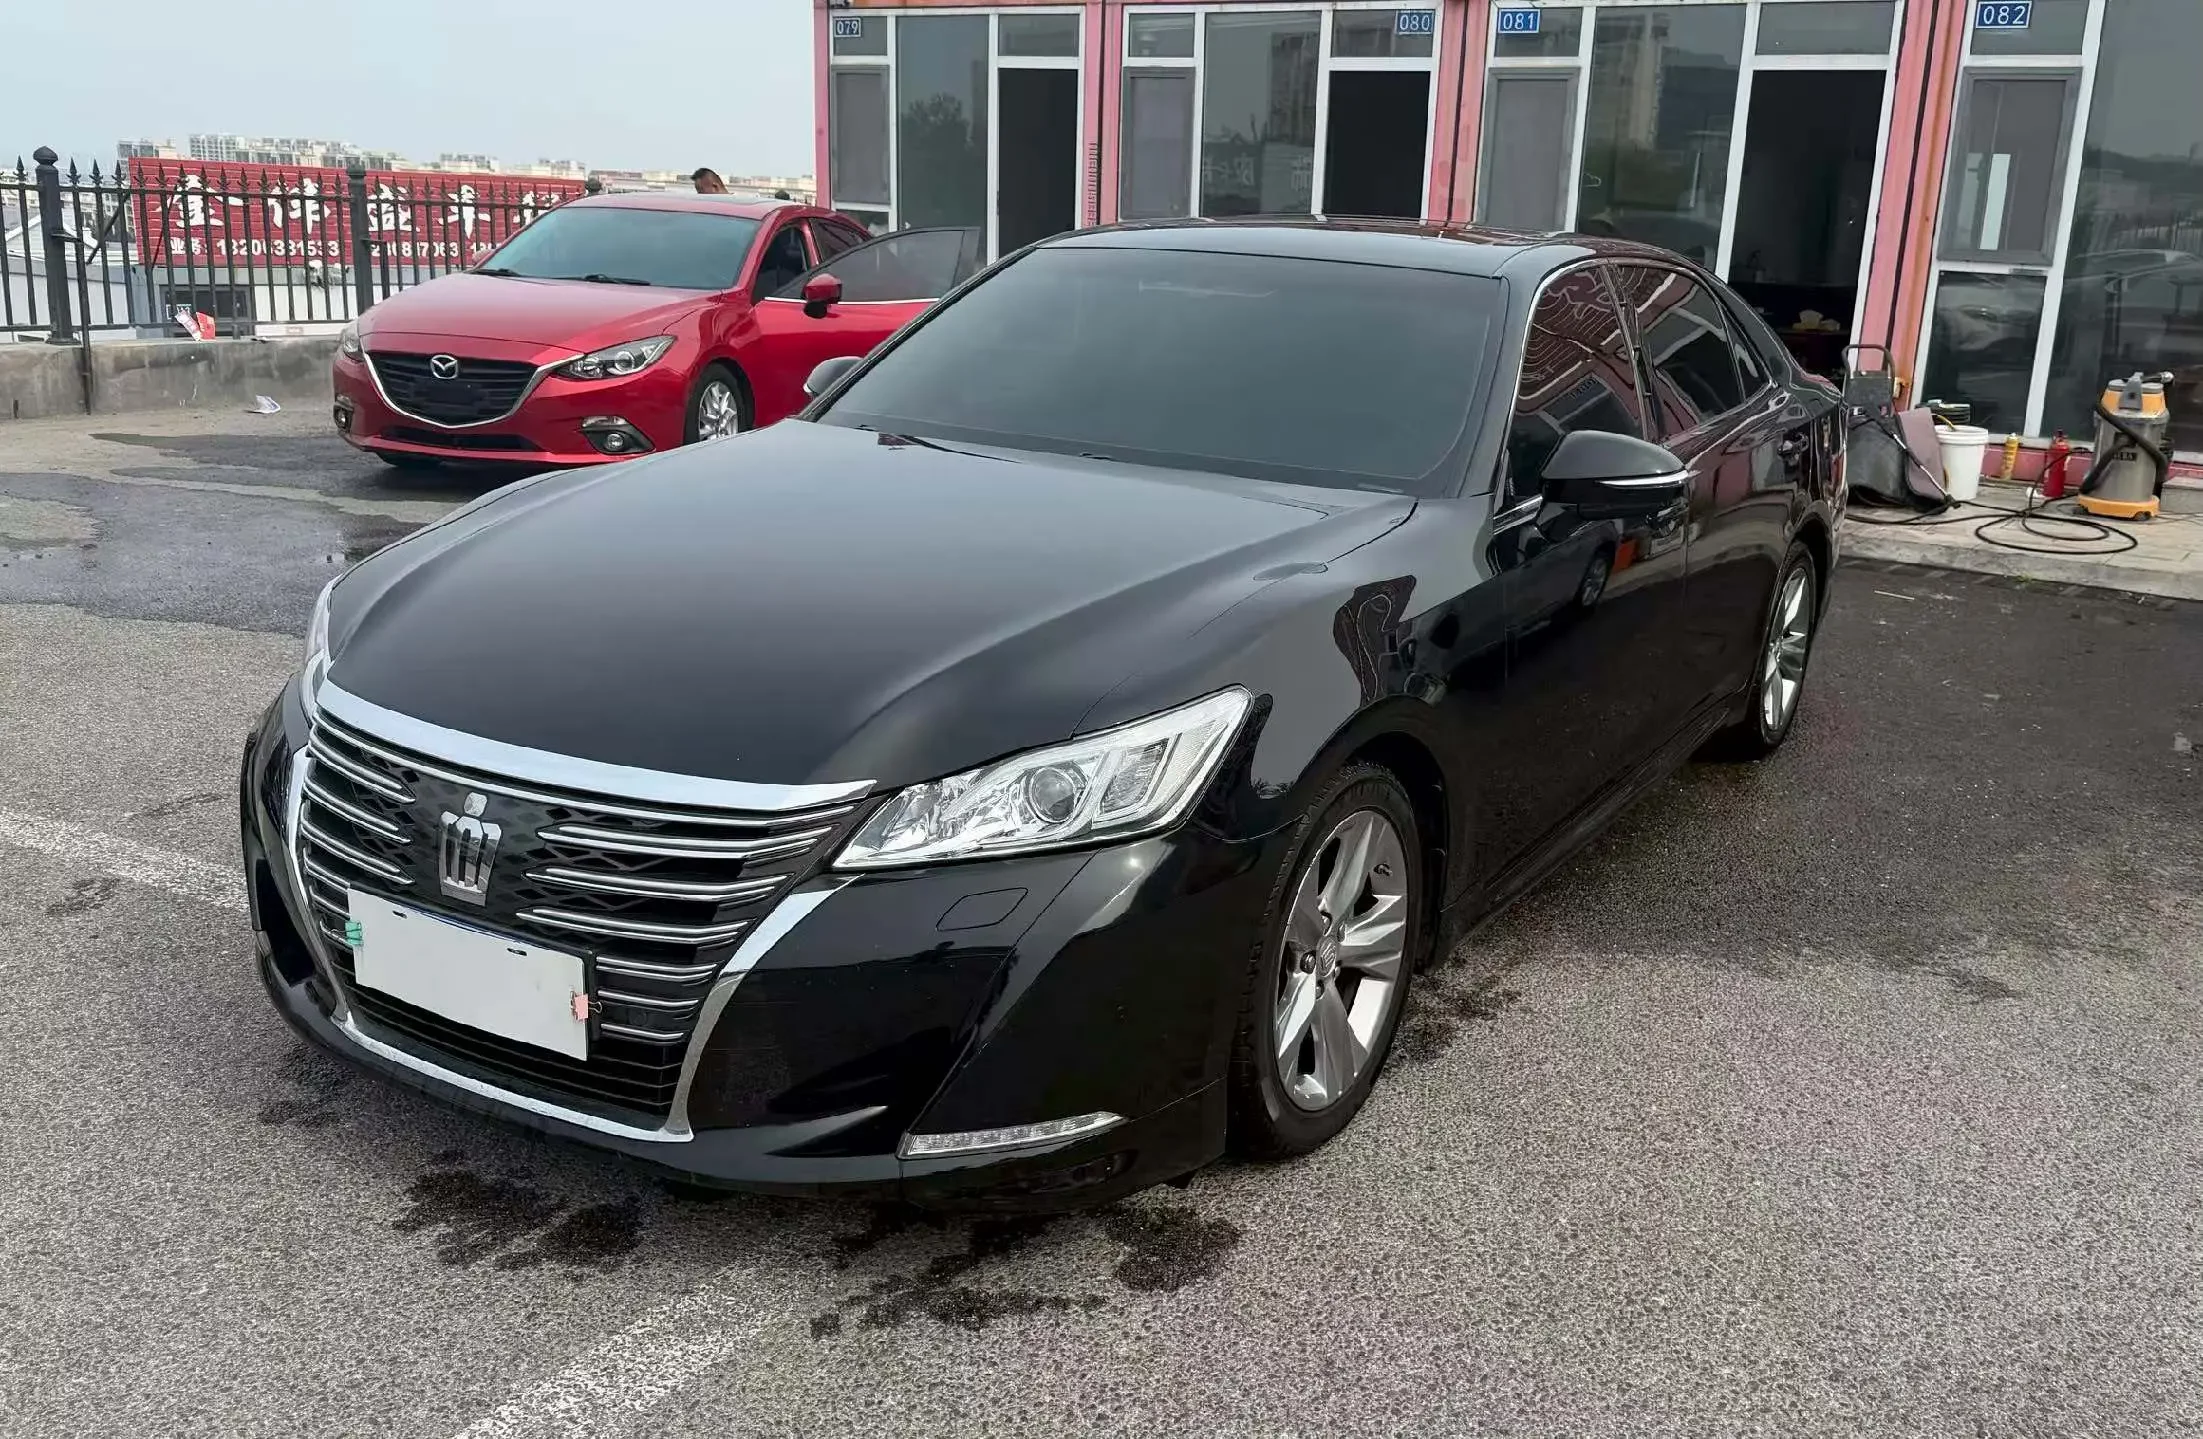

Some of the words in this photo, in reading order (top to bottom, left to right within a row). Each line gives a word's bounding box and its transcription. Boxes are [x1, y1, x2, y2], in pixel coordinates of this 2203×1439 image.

[1399, 14, 1430, 31] 080
[1503, 12, 1535, 30] 081
[1983, 5, 2026, 25] 082
[836, 20, 859, 35] 079
